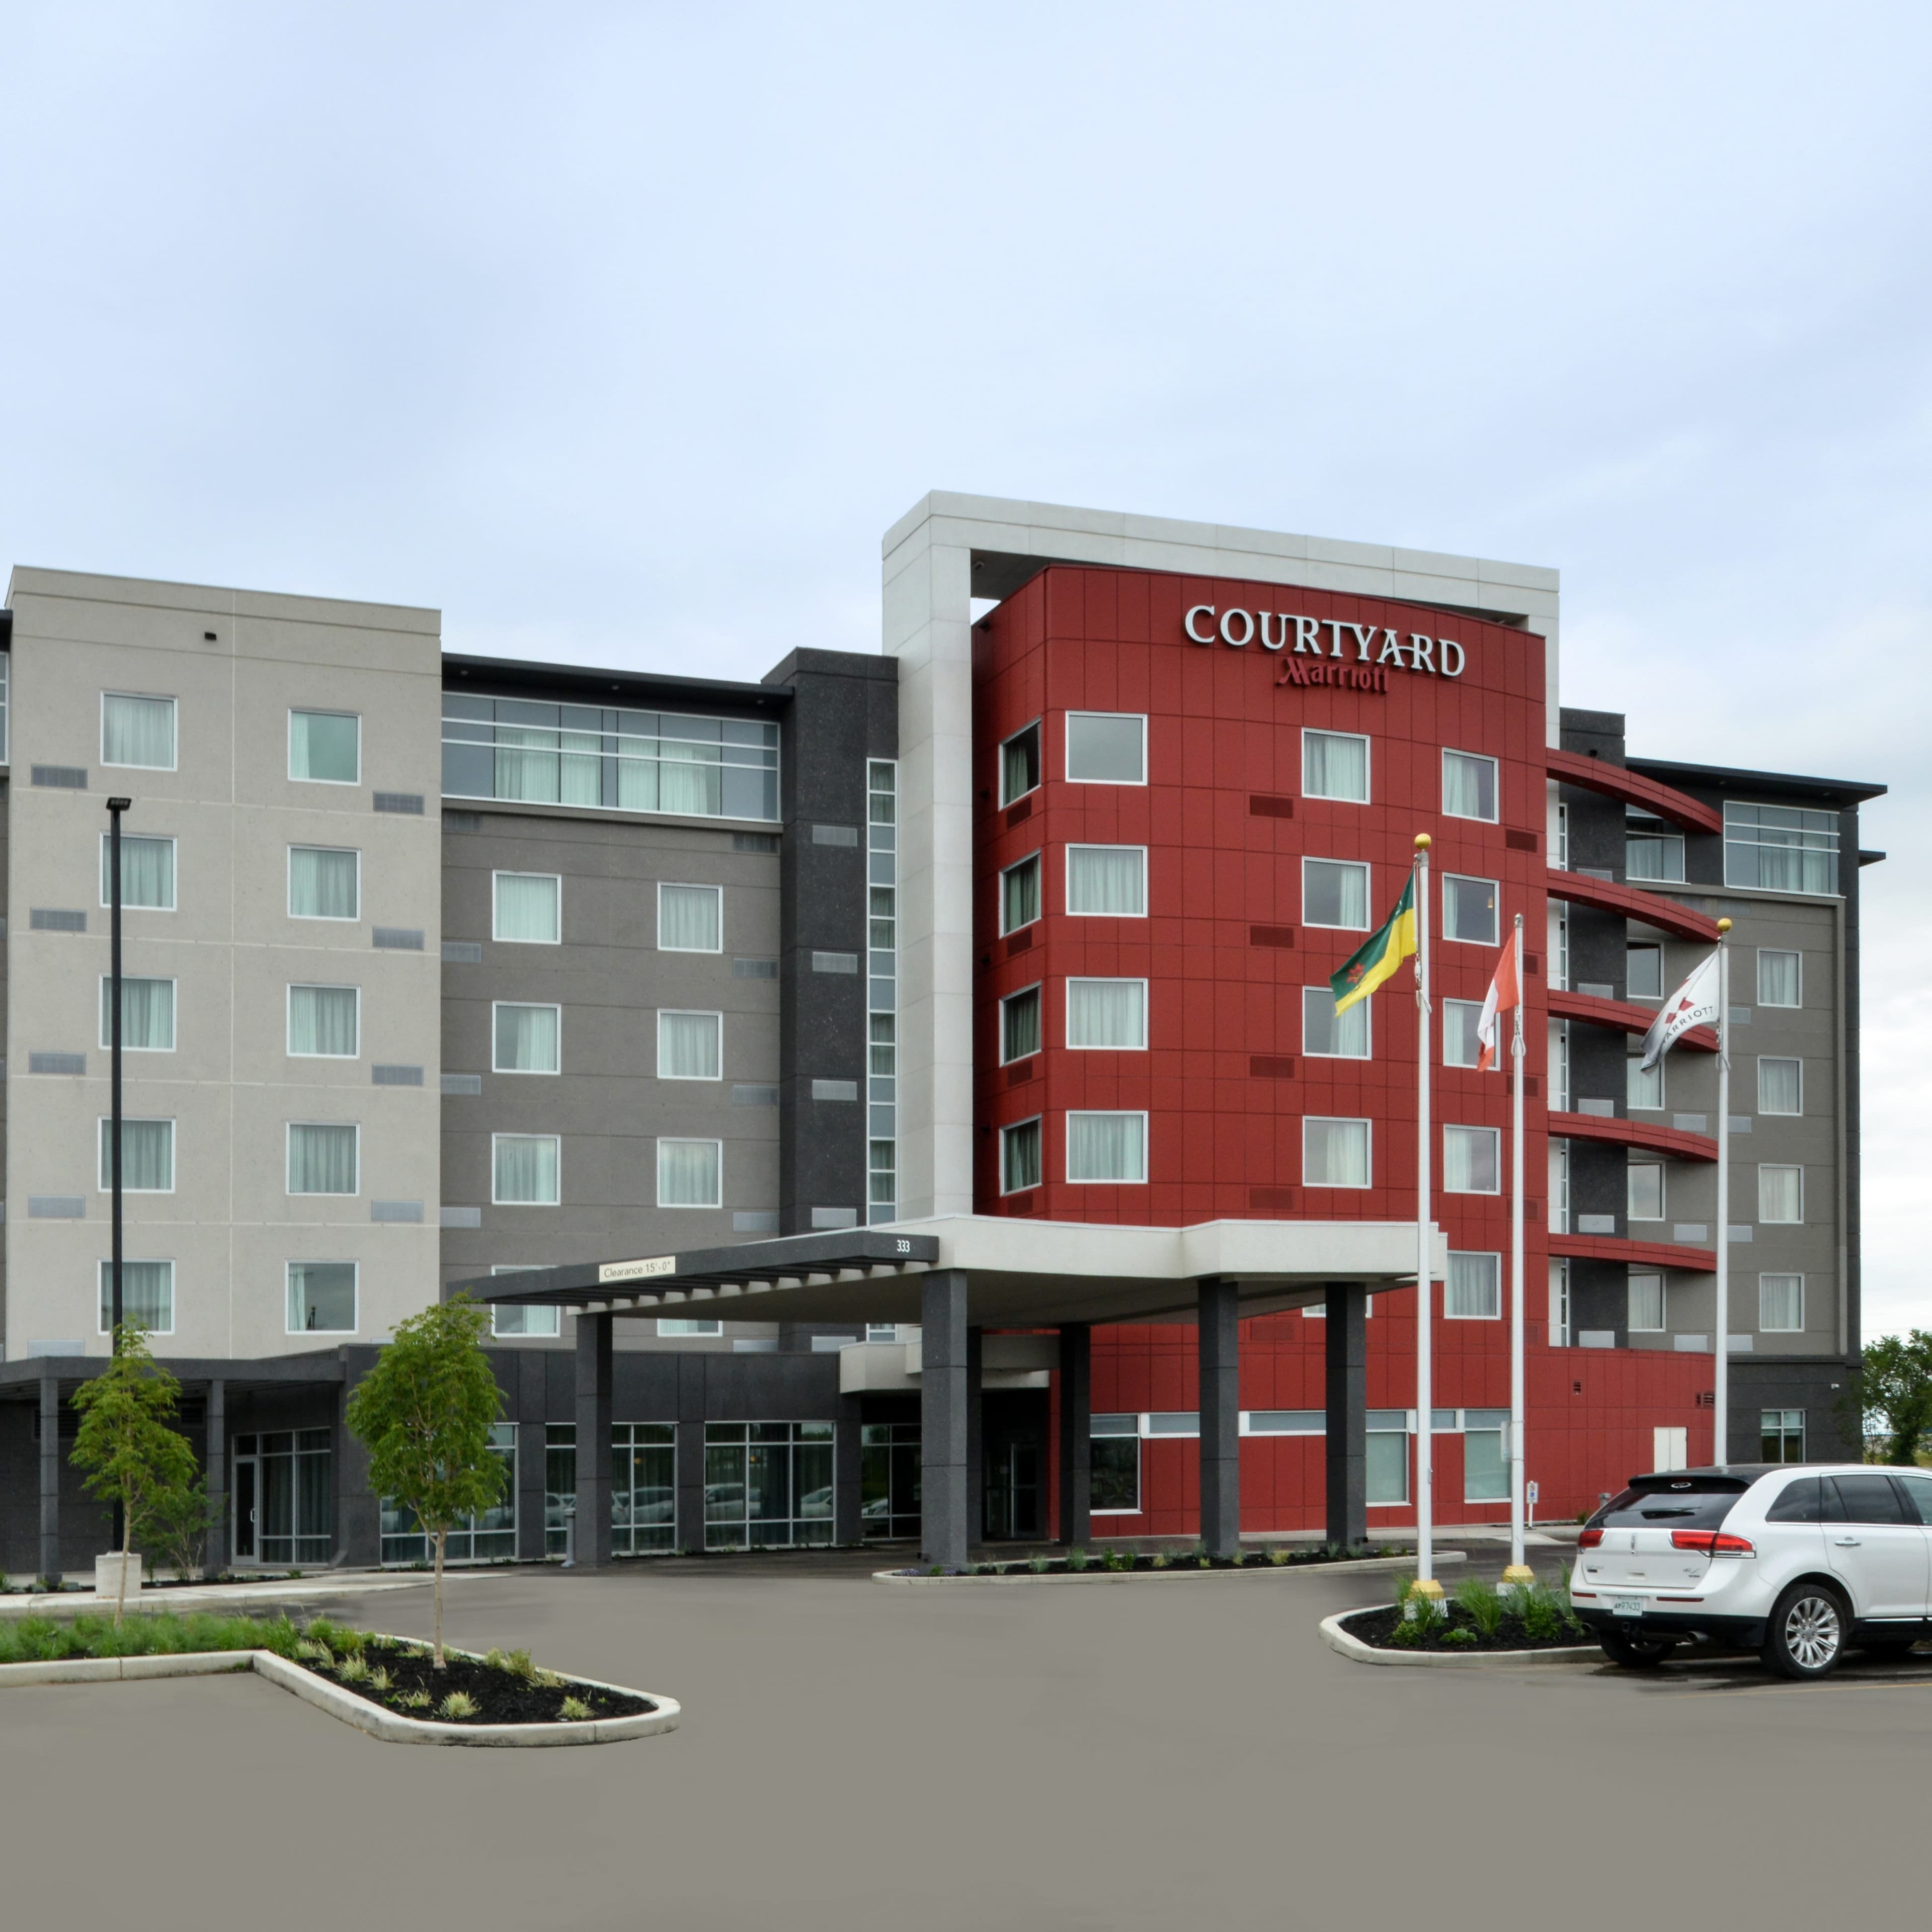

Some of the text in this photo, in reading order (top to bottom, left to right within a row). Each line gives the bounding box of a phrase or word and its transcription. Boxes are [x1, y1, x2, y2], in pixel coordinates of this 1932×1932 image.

[1185, 605, 1465, 677] COURTYARD
[1278, 656, 1389, 692] Marriott
[897, 1239, 910, 1253] 333
[604, 1266, 643, 1278] Clearance
